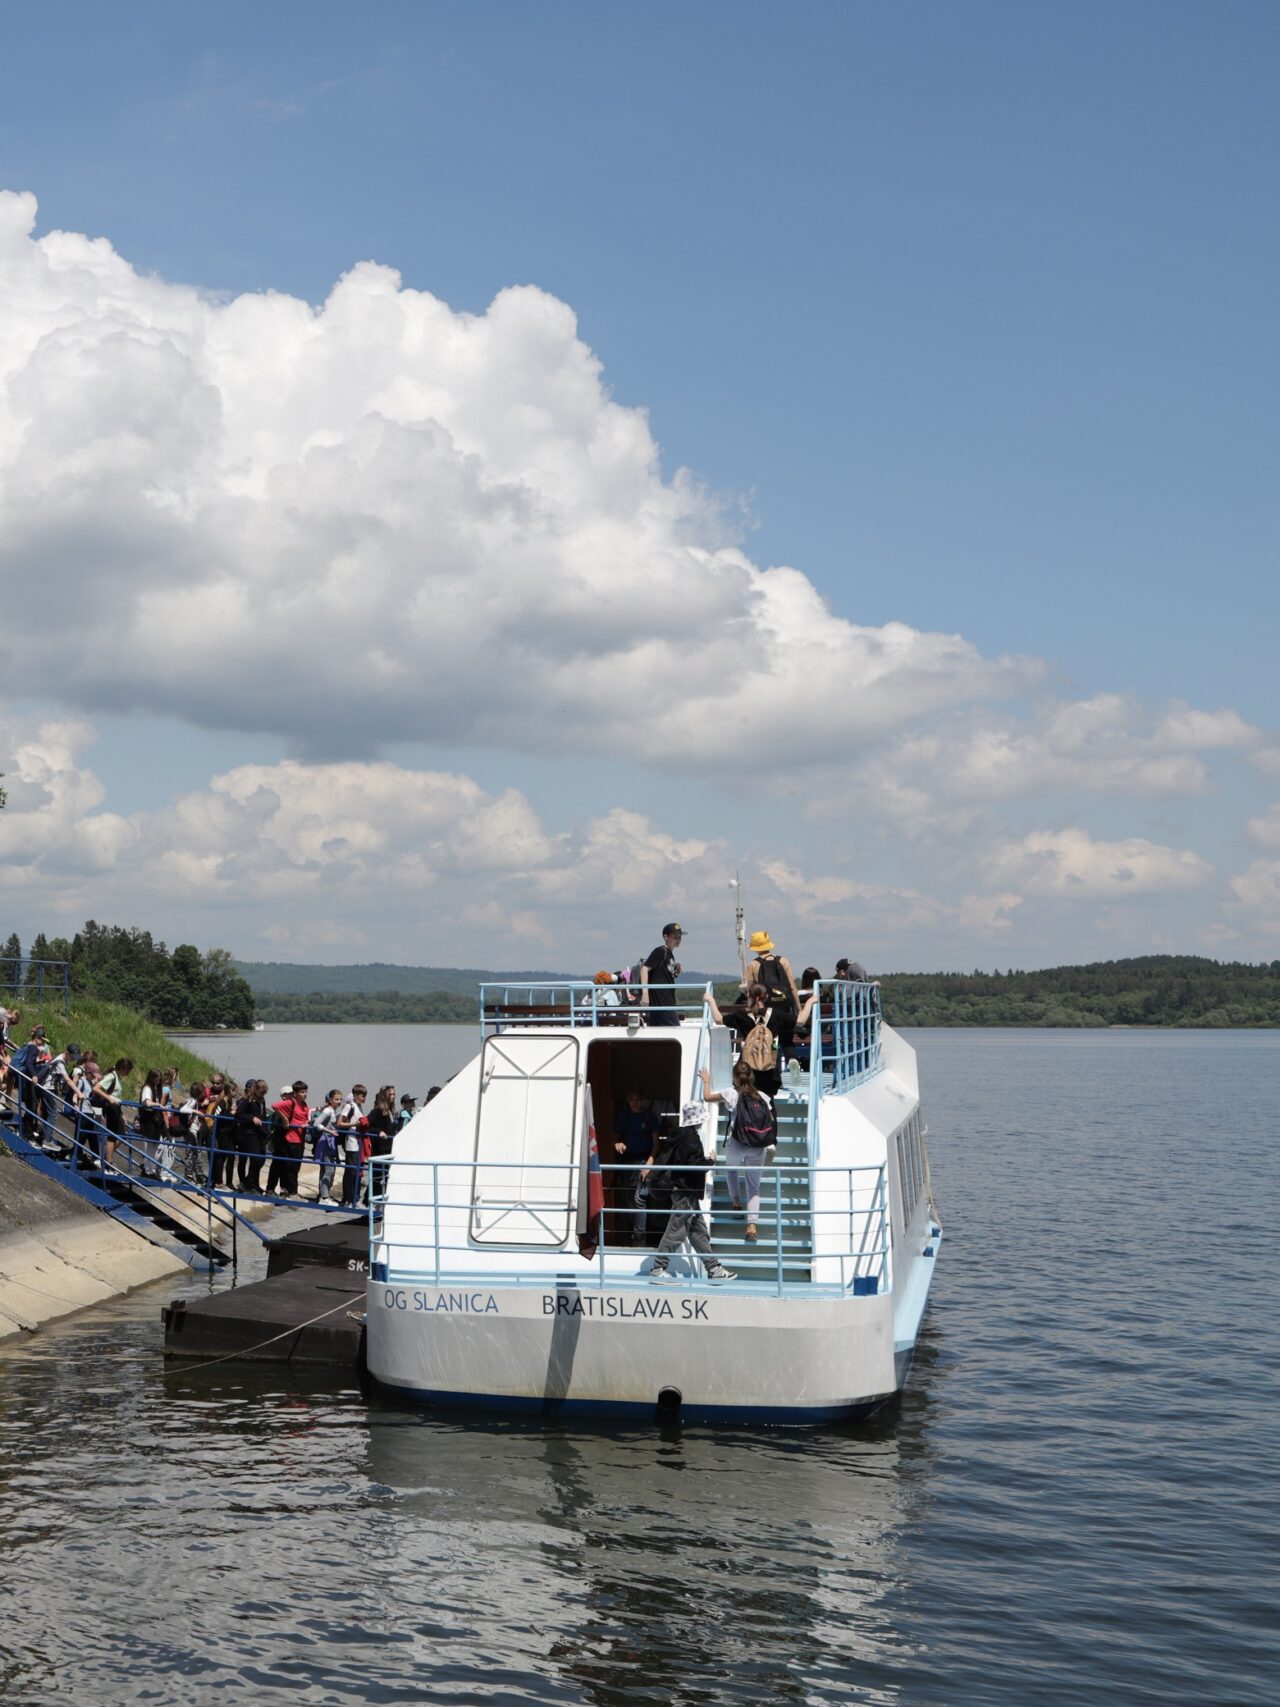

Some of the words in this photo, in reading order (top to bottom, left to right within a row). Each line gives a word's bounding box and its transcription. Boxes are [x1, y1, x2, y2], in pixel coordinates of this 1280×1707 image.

[384, 1289, 407, 1310] OG
[413, 1291, 499, 1313] SLANICA
[542, 1295, 674, 1318] BRATISLAVA
[681, 1299, 709, 1320] SK
